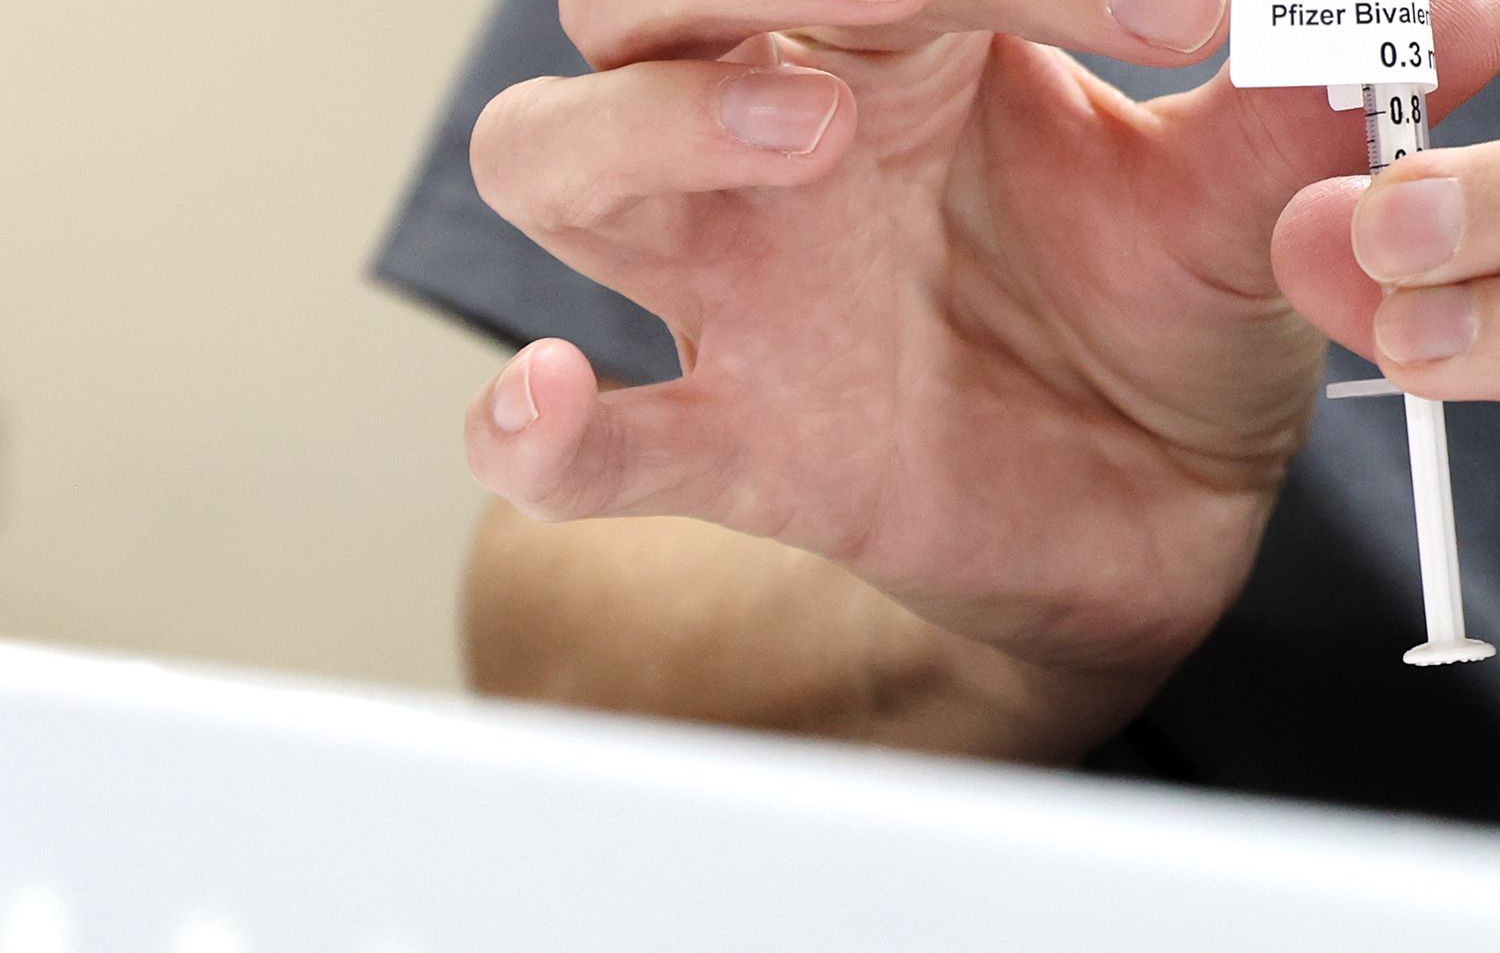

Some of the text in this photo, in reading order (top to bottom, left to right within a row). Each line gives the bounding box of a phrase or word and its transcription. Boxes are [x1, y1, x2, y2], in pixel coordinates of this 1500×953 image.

[1272, 4, 1346, 26] Pfizer
[1380, 42, 1422, 68] 0.3
[1390, 95, 1421, 125] 0.8
